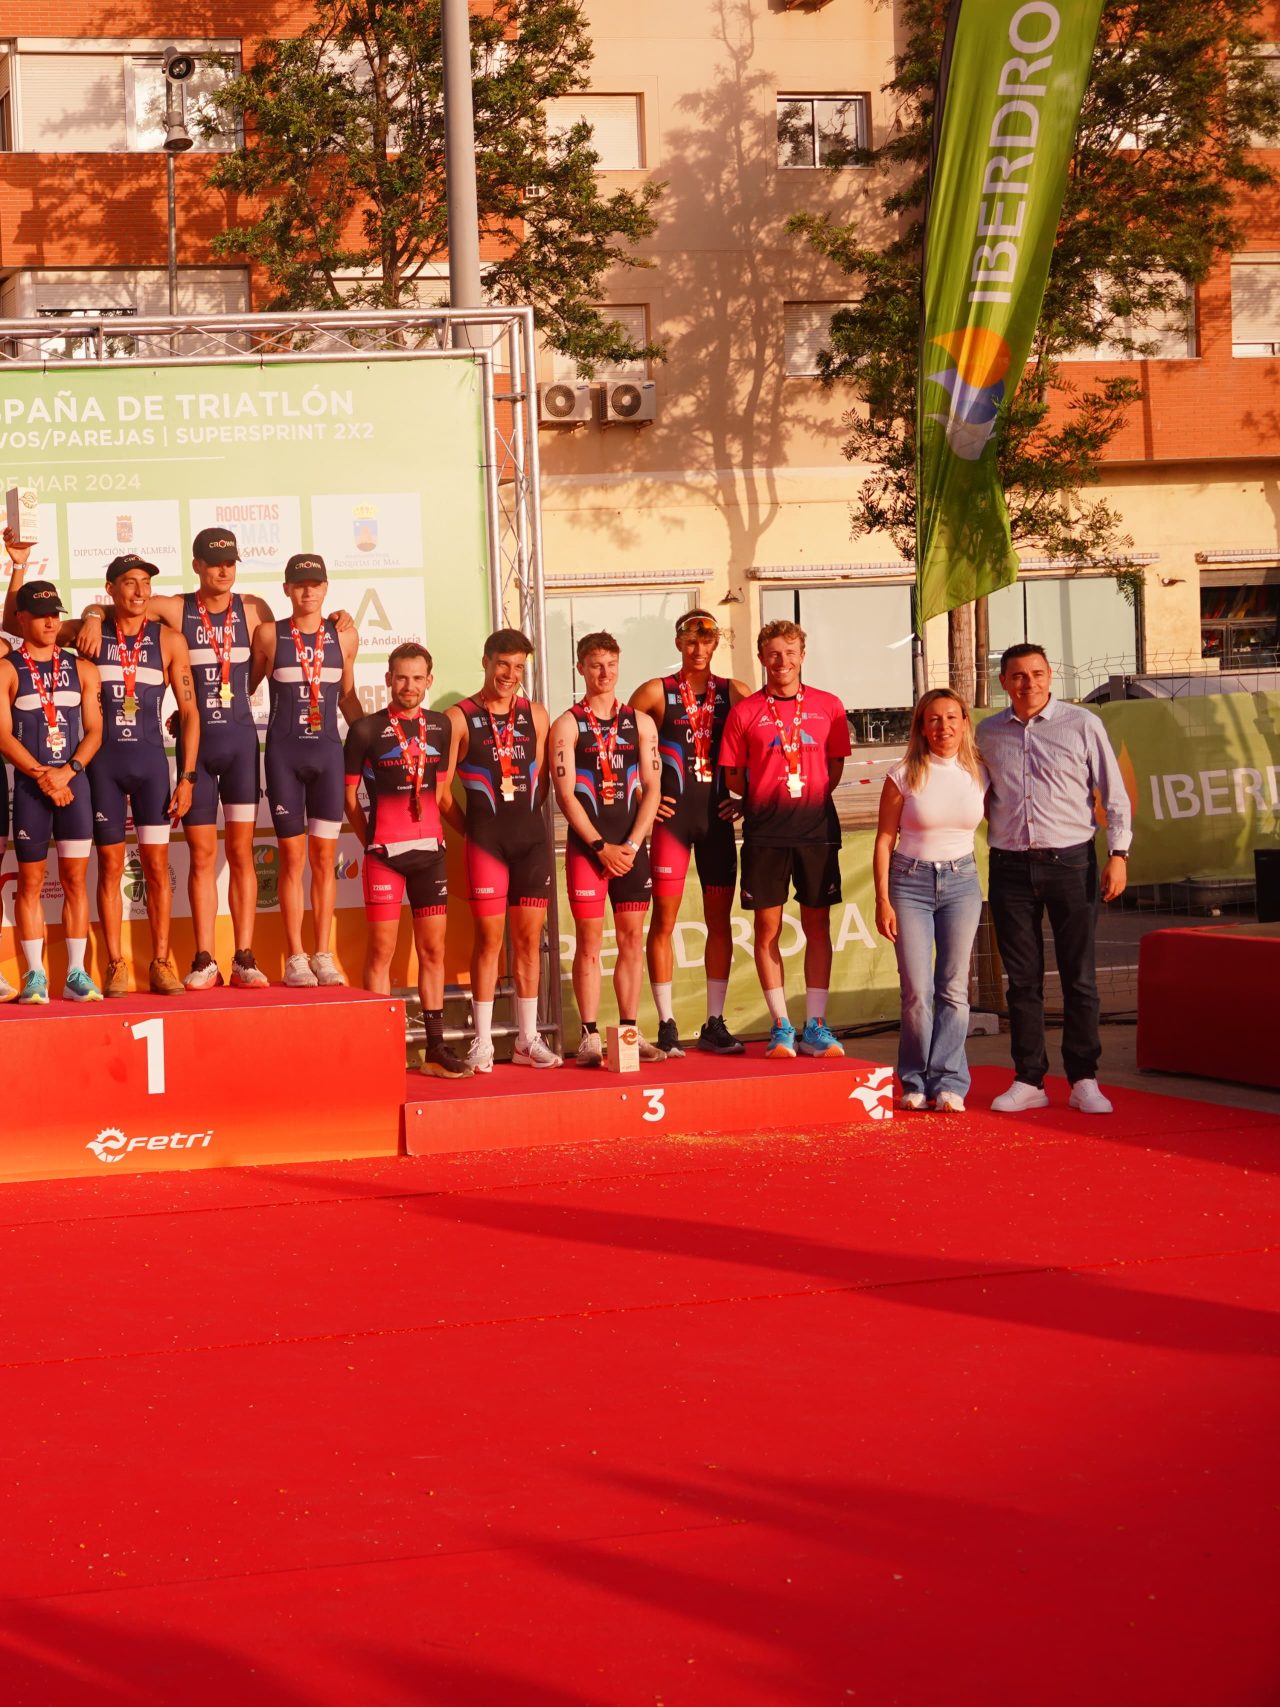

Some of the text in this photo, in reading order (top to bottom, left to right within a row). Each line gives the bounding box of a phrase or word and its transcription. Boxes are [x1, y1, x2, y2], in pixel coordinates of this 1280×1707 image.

[967, 0, 1061, 304] IBERDRO
[117, 395, 165, 423] DE
[176, 384, 354, 421] TRIATLÓN
[175, 423, 327, 444] SUPERSPRINT
[334, 422, 375, 440] 2X2
[25, 474, 78, 492] MAR
[86, 473, 142, 491] 2024
[215, 504, 280, 522] ROQUETAS
[241, 522, 281, 544] MAR
[73, 547, 128, 557] DIPUTACIÓN
[143, 545, 177, 556] ALMERÍA
[182, 675, 190, 687] 6
[556, 750, 565, 763] 1
[556, 765, 566, 778] D
[131, 1017, 166, 1094] 1
[642, 1088, 665, 1122] 3
